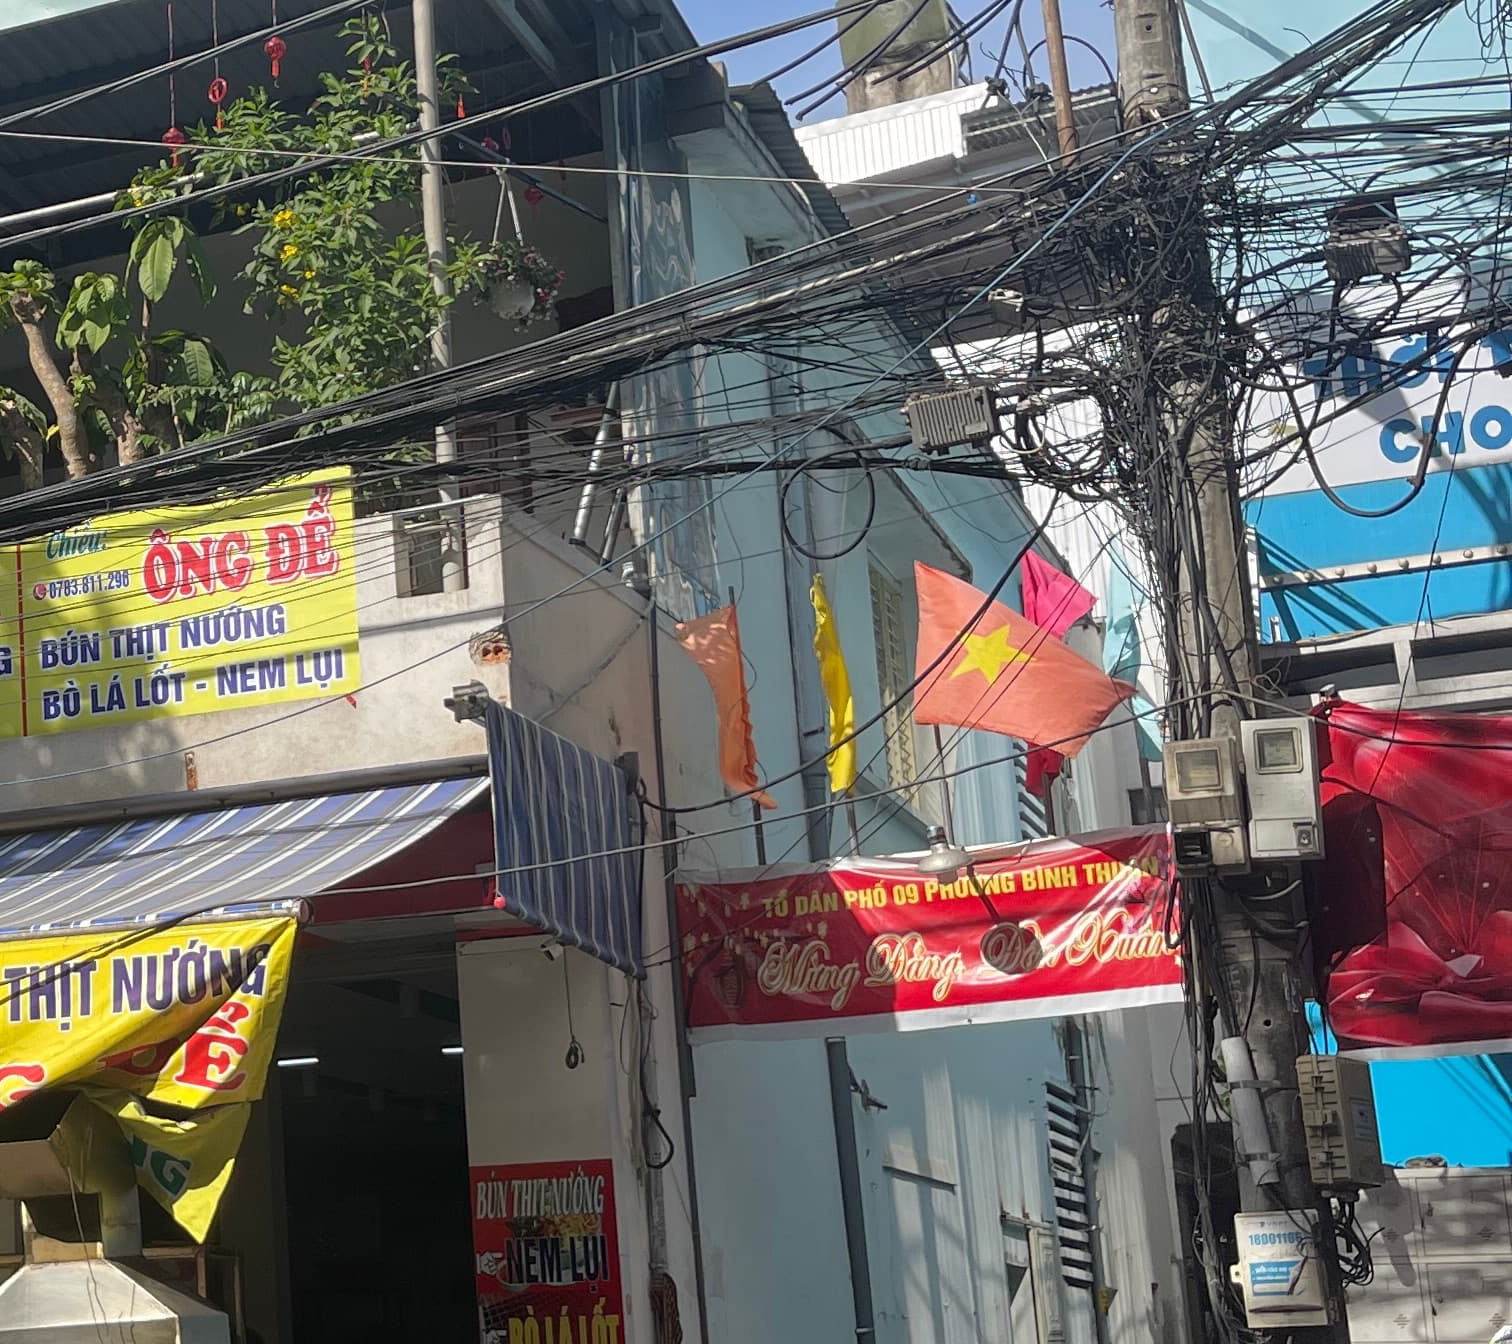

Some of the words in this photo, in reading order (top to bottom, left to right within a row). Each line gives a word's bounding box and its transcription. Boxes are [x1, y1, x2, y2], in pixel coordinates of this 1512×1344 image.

[1379, 406, 1512, 463] CHO
[142, 529, 250, 606] ÔNG
[41, 629, 100, 670] BÚN
[109, 624, 171, 663] THỊT
[179, 604, 285, 651] NƯỚNG
[42, 682, 80, 721] BÒ
[90, 674, 126, 713] LÁ
[133, 660, 186, 707] LỐT
[217, 656, 284, 696] NEM
[296, 648, 343, 694] LỤI
[795, 891, 838, 916] DÂN
[844, 880, 887, 910] PHỐ
[894, 883, 919, 904] 09
[1020, 863, 1078, 892] BÌNH
[3, 960, 98, 1031] THỊT
[111, 937, 269, 1014] NƯỚNG
[477, 1170, 508, 1220] BÚN
[550, 1164, 605, 1216] NƯỚNG
[505, 1236, 562, 1285] NEM
[570, 1233, 610, 1294] LỤI
